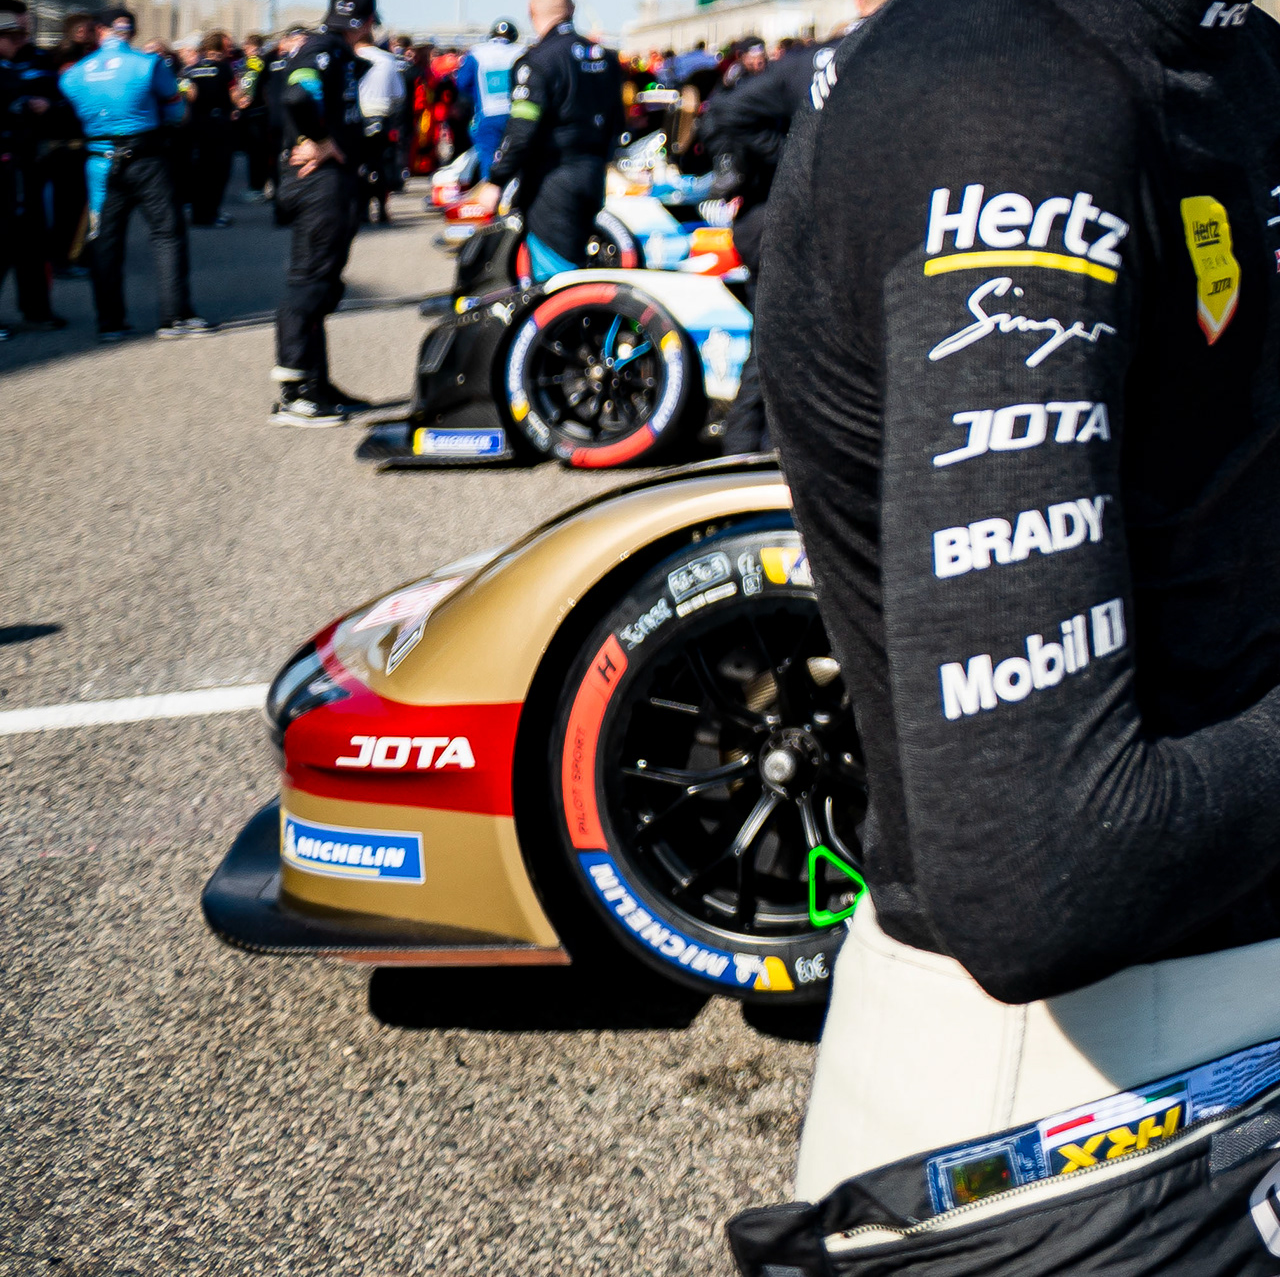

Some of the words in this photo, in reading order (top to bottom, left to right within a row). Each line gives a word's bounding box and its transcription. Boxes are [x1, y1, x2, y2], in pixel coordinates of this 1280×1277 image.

[925, 184, 1130, 267] Hertz
[929, 277, 1118, 368] Singer
[933, 401, 1111, 467] JOTA
[932, 497, 1105, 579] BRADY
[939, 615, 1089, 720] Mobil
[1091, 597, 1127, 657] 1
[335, 736, 476, 769] JOTA
[297, 836, 406, 868] MICHELIN
[589, 862, 730, 978] MICHELIN
